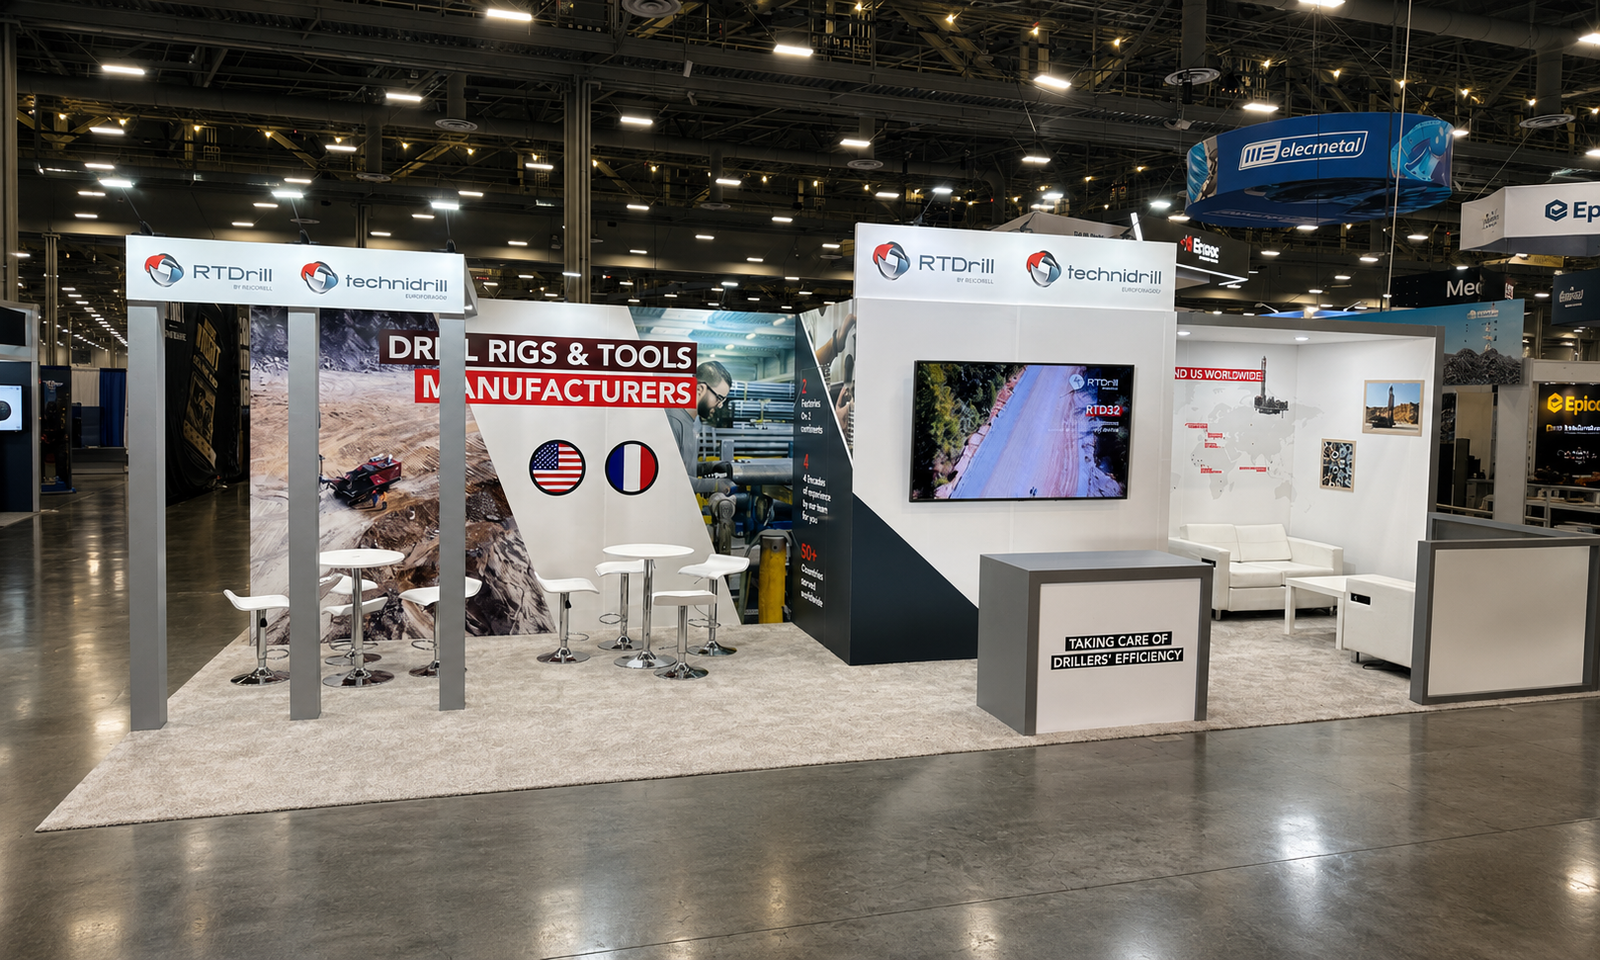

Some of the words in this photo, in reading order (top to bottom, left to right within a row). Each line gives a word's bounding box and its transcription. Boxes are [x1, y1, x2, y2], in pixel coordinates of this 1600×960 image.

[1281, 137, 1361, 158] elecmetal
[1573, 201, 1600, 223] Ep
[193, 264, 273, 282] RTDrill
[919, 254, 995, 274] RTDrill
[345, 274, 448, 292] technidrill
[1068, 265, 1162, 285] technidrill
[388, 335, 479, 362] DRIL
[488, 339, 558, 365] RIGS
[567, 342, 590, 366] &
[597, 343, 692, 370] TOOLS
[1190, 369, 1203, 379] US
[1204, 369, 1262, 381] WORLDWIDE
[801, 378, 808, 394] 2
[1086, 404, 1121, 415] RTD32
[803, 453, 809, 470] 4
[801, 542, 818, 562] 50+
[1068, 636, 1115, 650] TAKING
[1117, 634, 1149, 647] CARE
[1152, 633, 1169, 645] OF
[1053, 653, 1112, 669] DRILLERS'
[1115, 649, 1182, 665] EFFICIENCY
